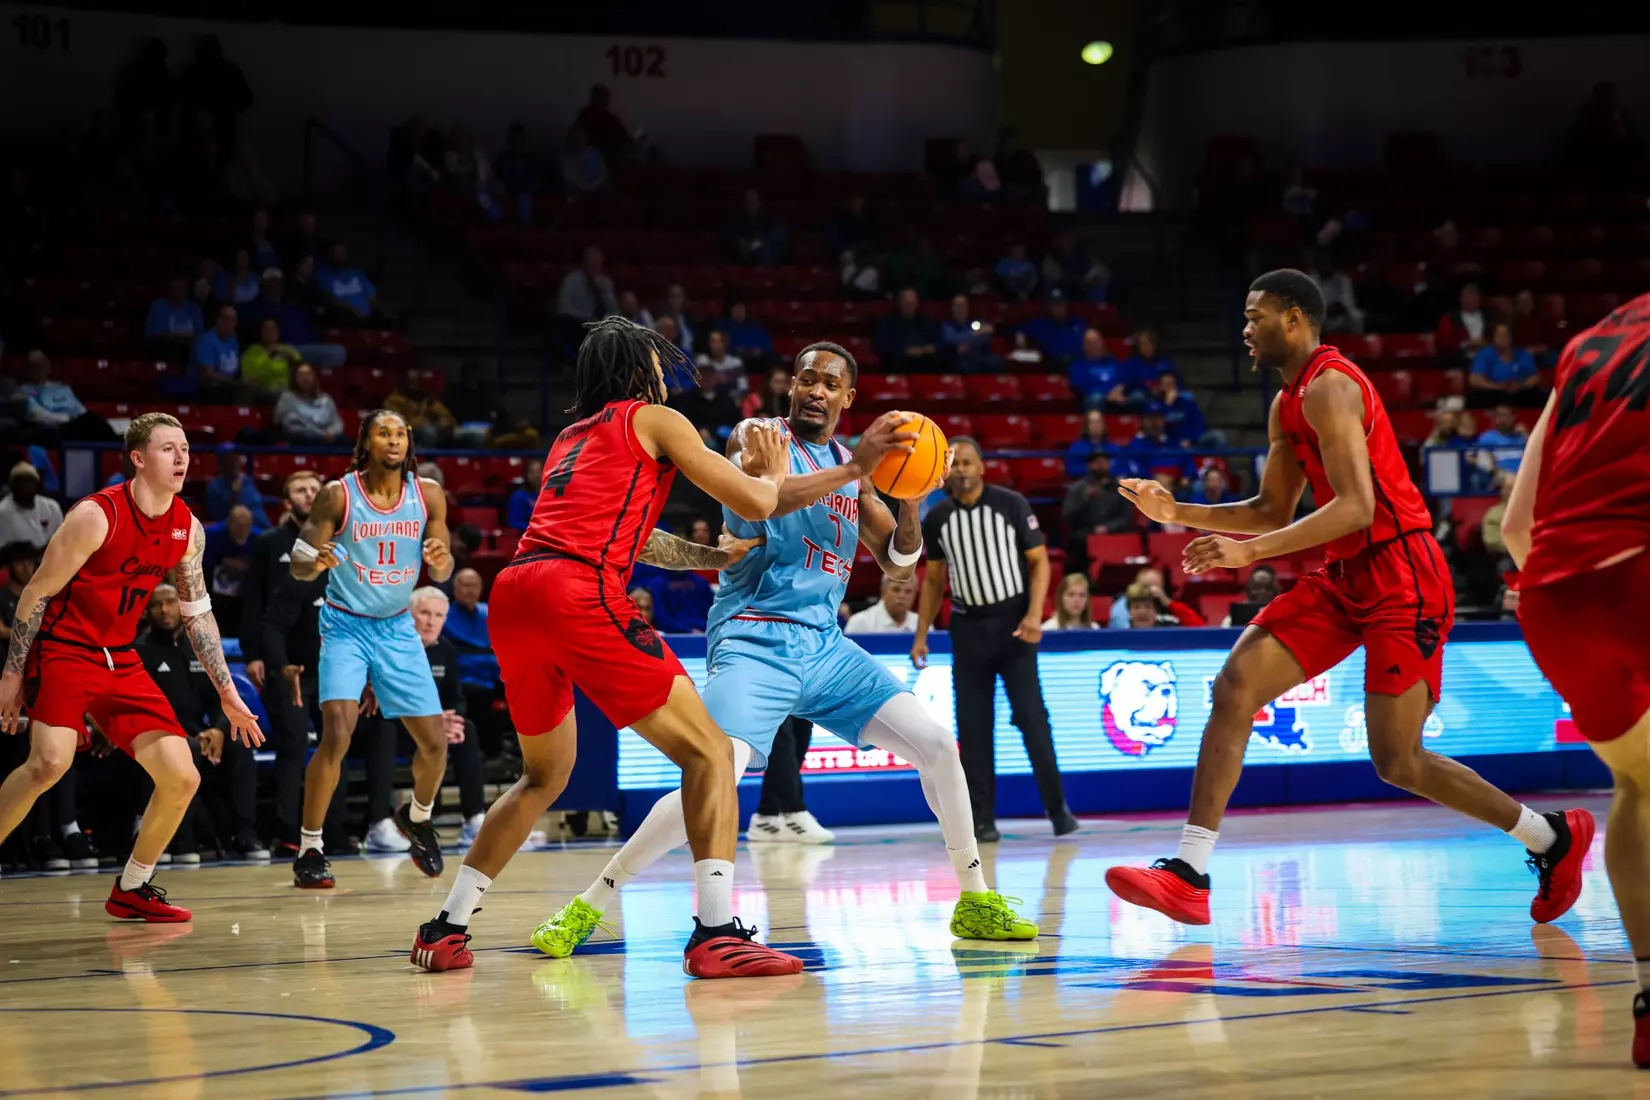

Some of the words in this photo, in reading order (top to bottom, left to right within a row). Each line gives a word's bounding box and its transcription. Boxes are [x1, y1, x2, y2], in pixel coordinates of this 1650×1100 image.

[12, 14, 70, 50] 101
[605, 45, 667, 77] 102
[543, 436, 588, 498] 4
[353, 521, 420, 542] LOUISIANA
[377, 541, 396, 565] 11
[352, 560, 417, 585] TECH
